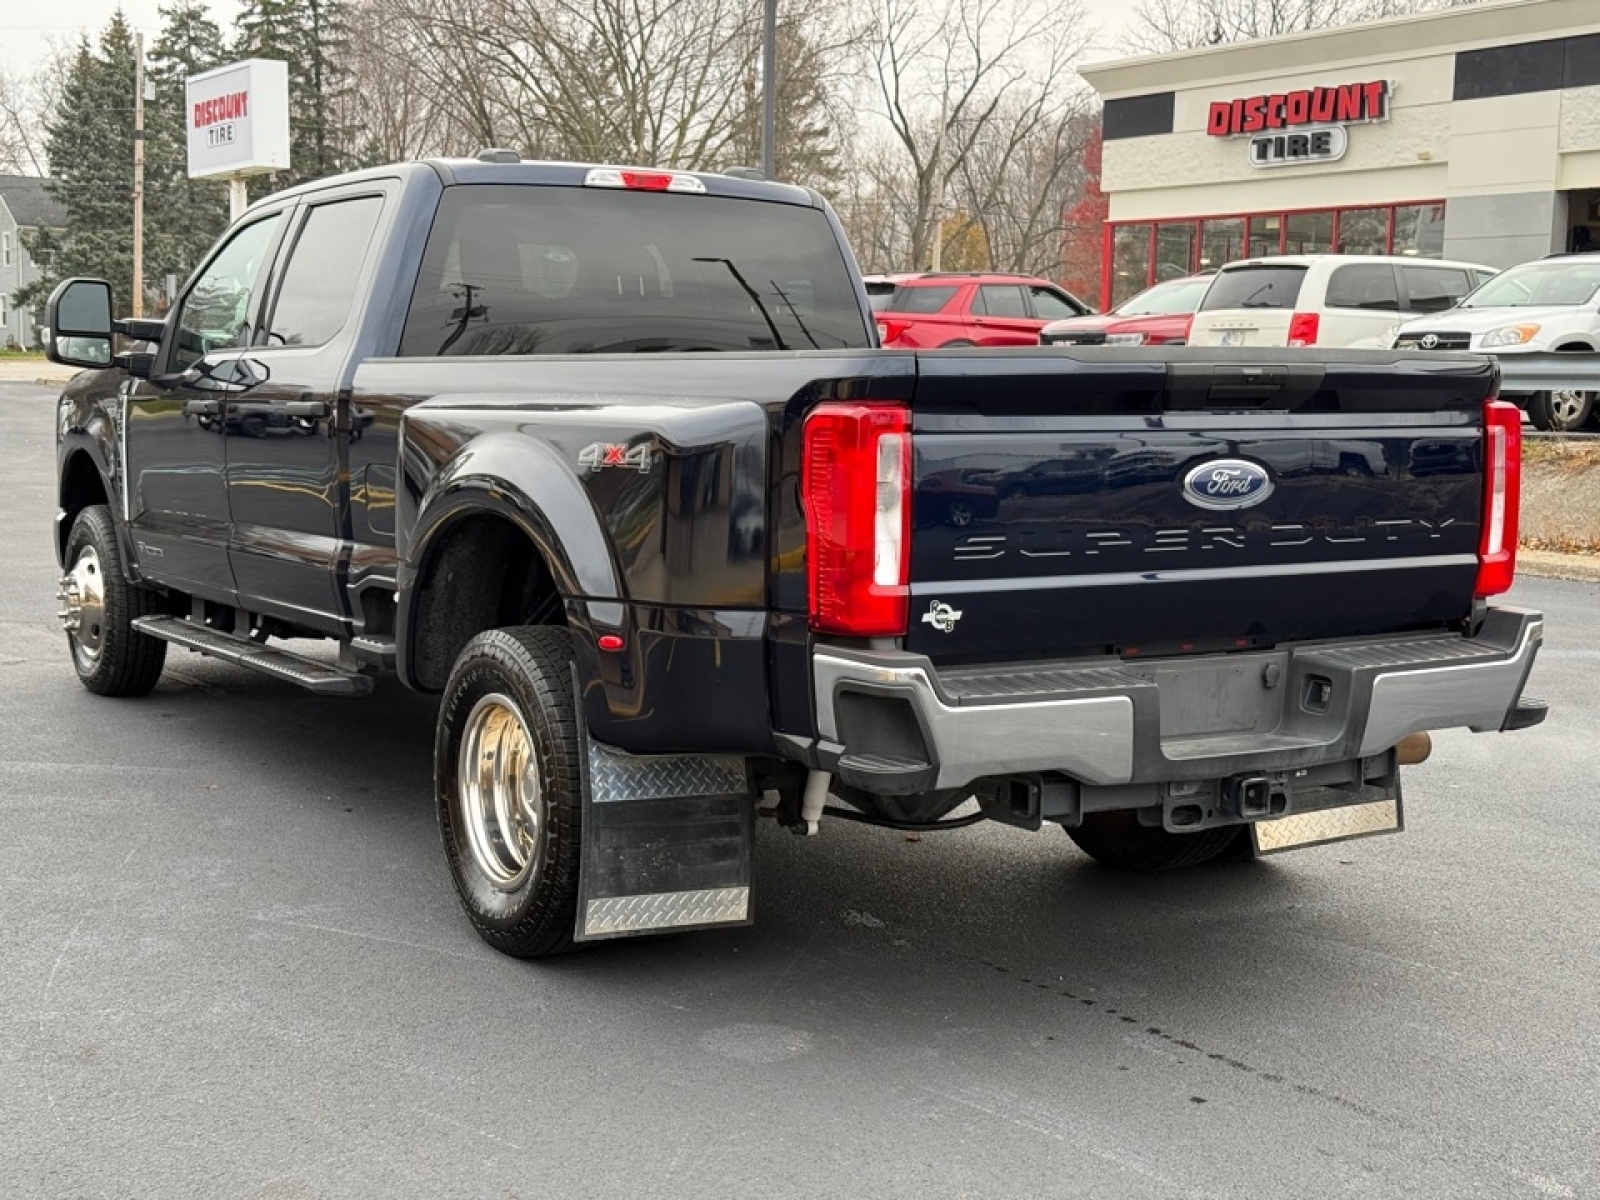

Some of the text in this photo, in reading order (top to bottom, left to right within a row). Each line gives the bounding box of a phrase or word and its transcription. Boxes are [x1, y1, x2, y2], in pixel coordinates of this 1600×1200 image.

[194, 91, 248, 128] DISCOUNT
[1207, 80, 1387, 137] DISCOUNT
[209, 125, 233, 145] TIRE
[1252, 131, 1331, 160] TIRE
[1207, 469, 1252, 494] Ford
[953, 518, 1454, 560] SUPER DUTY
